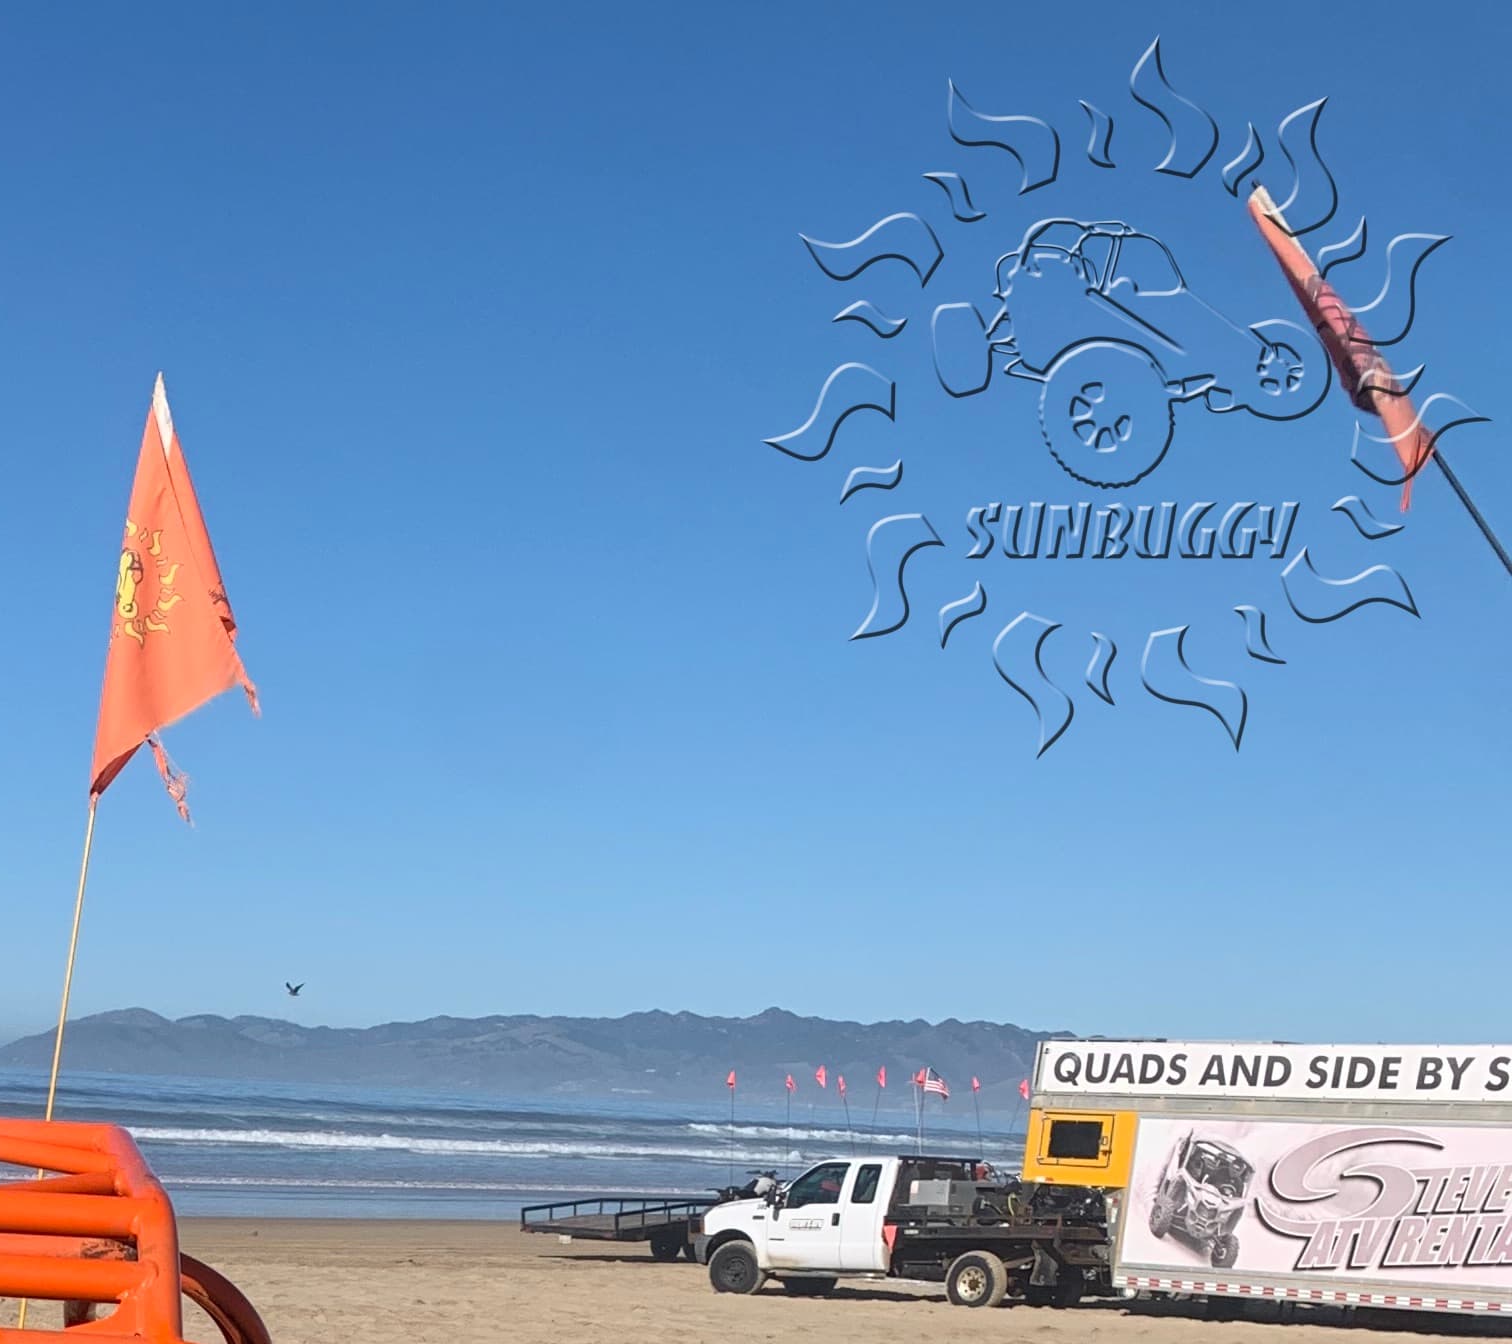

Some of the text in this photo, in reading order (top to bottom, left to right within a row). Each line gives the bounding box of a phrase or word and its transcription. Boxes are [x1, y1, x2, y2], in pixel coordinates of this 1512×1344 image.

[1053, 1052, 1512, 1092] QUADS AND SIDE BY S
[1293, 1219, 1394, 1271] ATV
